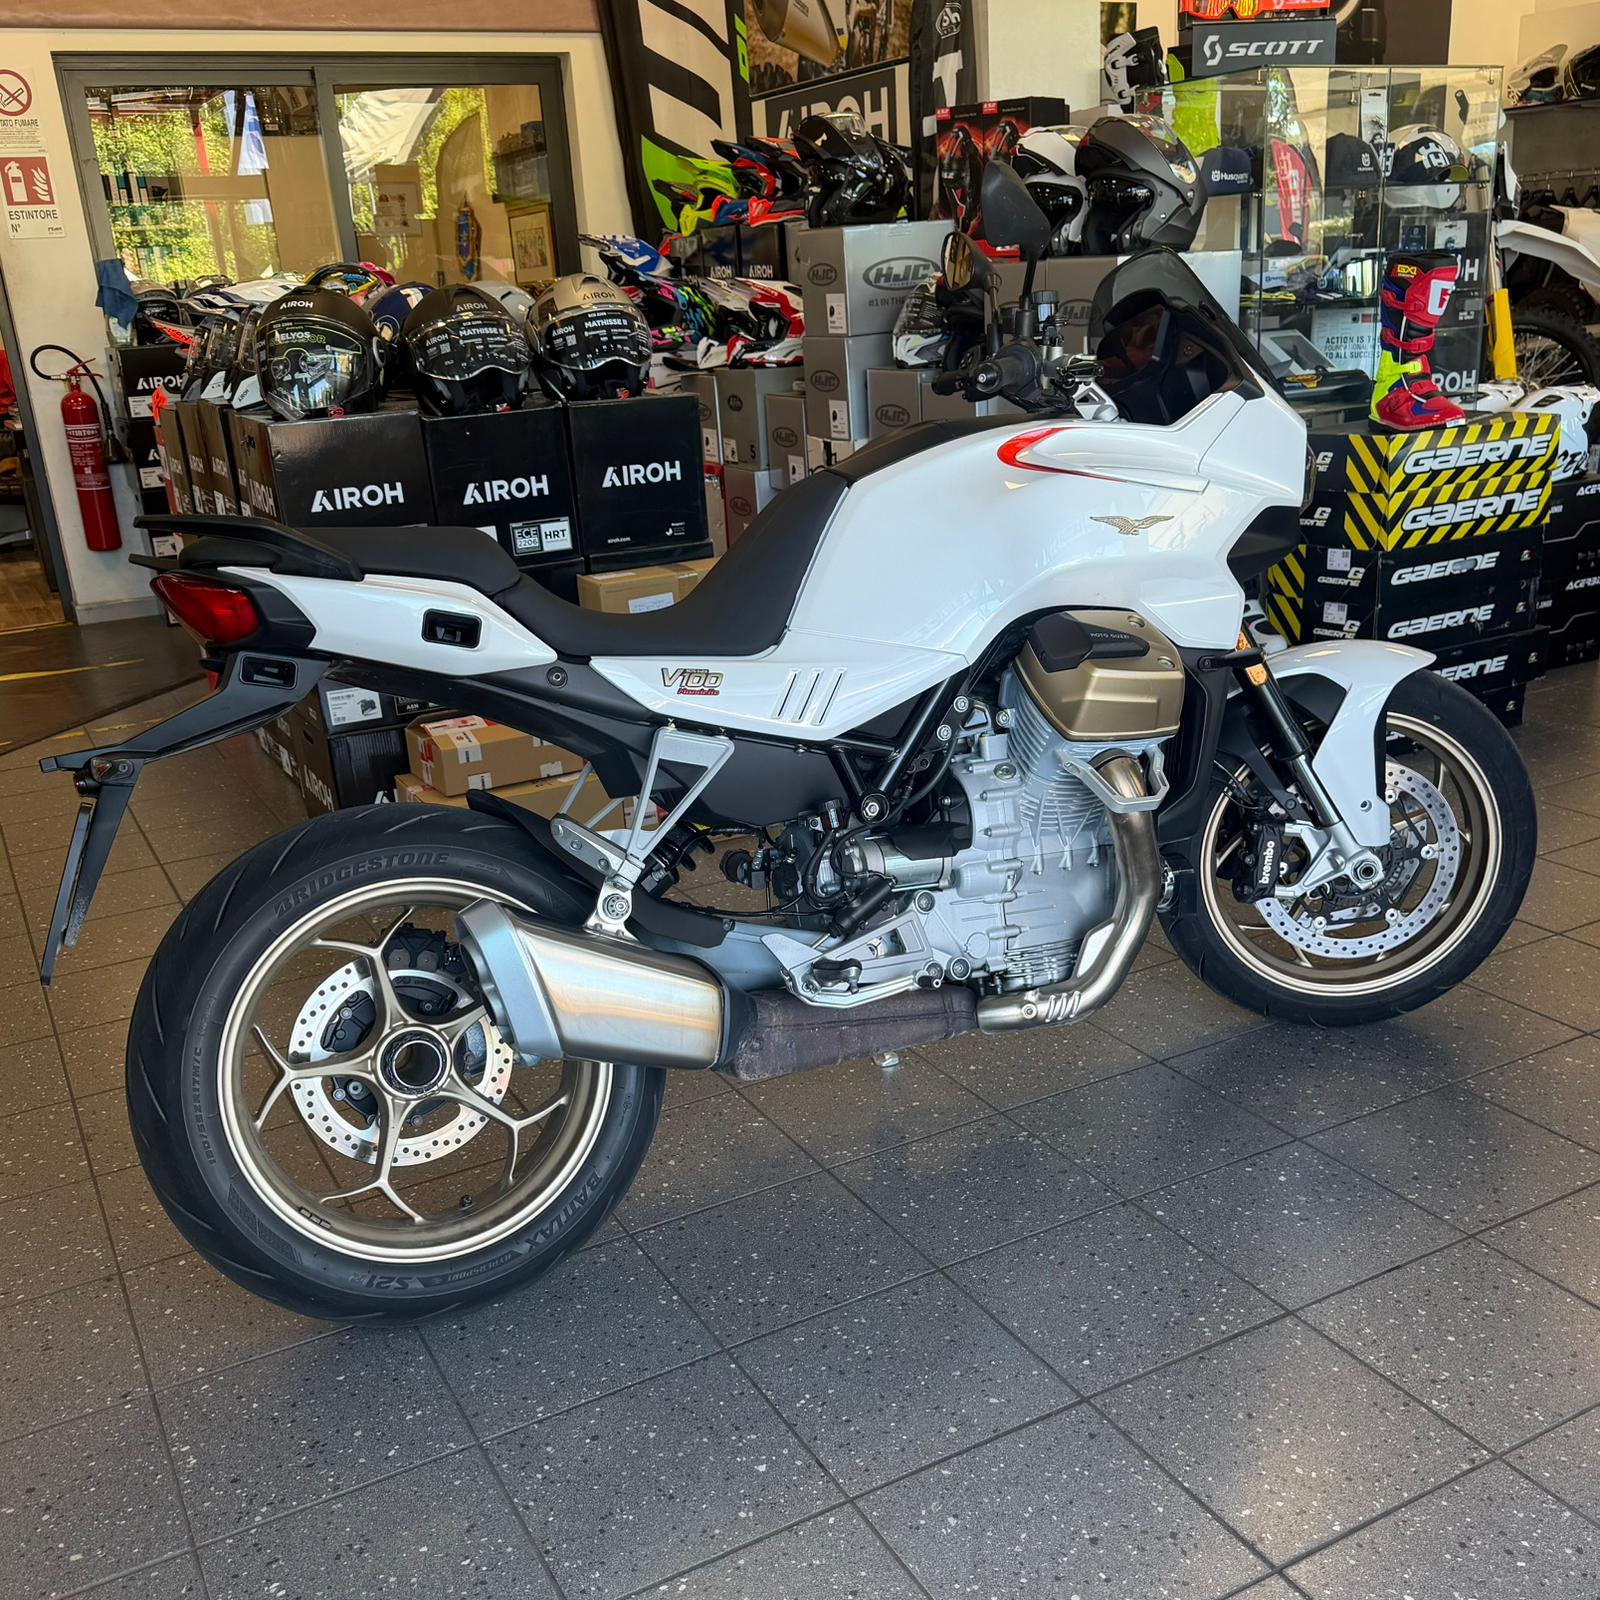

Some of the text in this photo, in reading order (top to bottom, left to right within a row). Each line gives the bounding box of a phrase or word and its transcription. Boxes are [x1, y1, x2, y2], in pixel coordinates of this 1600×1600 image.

[1225, 40, 1324, 57] SCOTT
[14, 118, 39, 127] FUMARE
[8, 209, 58, 220] ESTINTORE
[710, 264, 732, 278] AIROH
[749, 264, 773, 278] AIROH
[811, 269, 833, 280] HJC
[873, 263, 931, 284] HJC
[583, 291, 616, 301] AIROH
[280, 300, 314, 309] AIROH
[456, 302, 488, 312] AIROH
[584, 319, 622, 329] MATHISSE
[275, 330, 311, 341] ELYOS
[459, 327, 498, 337] MATHISSE
[552, 325, 575, 337] AIROH
[425, 333, 449, 346] AIROH
[1325, 336, 1354, 344] ACTION
[1325, 351, 1334, 359] TO
[1335, 351, 1347, 359] ALL
[137, 375, 187, 390] AIROH
[814, 375, 836, 387] HJC
[879, 410, 908, 423] HJC
[1404, 434, 1552, 474] GAERNE
[602, 460, 682, 488] AIROH
[463, 475, 550, 505] AIROH
[250, 478, 277, 517] AIROH
[311, 482, 405, 513] AIROH
[1402, 488, 1542, 531] GAERNE
[516, 527, 538, 539] ECE
[544, 529, 567, 540] HRT
[518, 538, 538, 547] 2206
[1387, 603, 1495, 639] GAERNE
[1432, 655, 1509, 682] ERNE
[661, 667, 724, 688] V100
[1259, 840, 1275, 884] brembo
[273, 852, 450, 919] BRIDGESTONE
[525, 1169, 602, 1252] BATTLAX
[364, 1274, 411, 1291] S21
